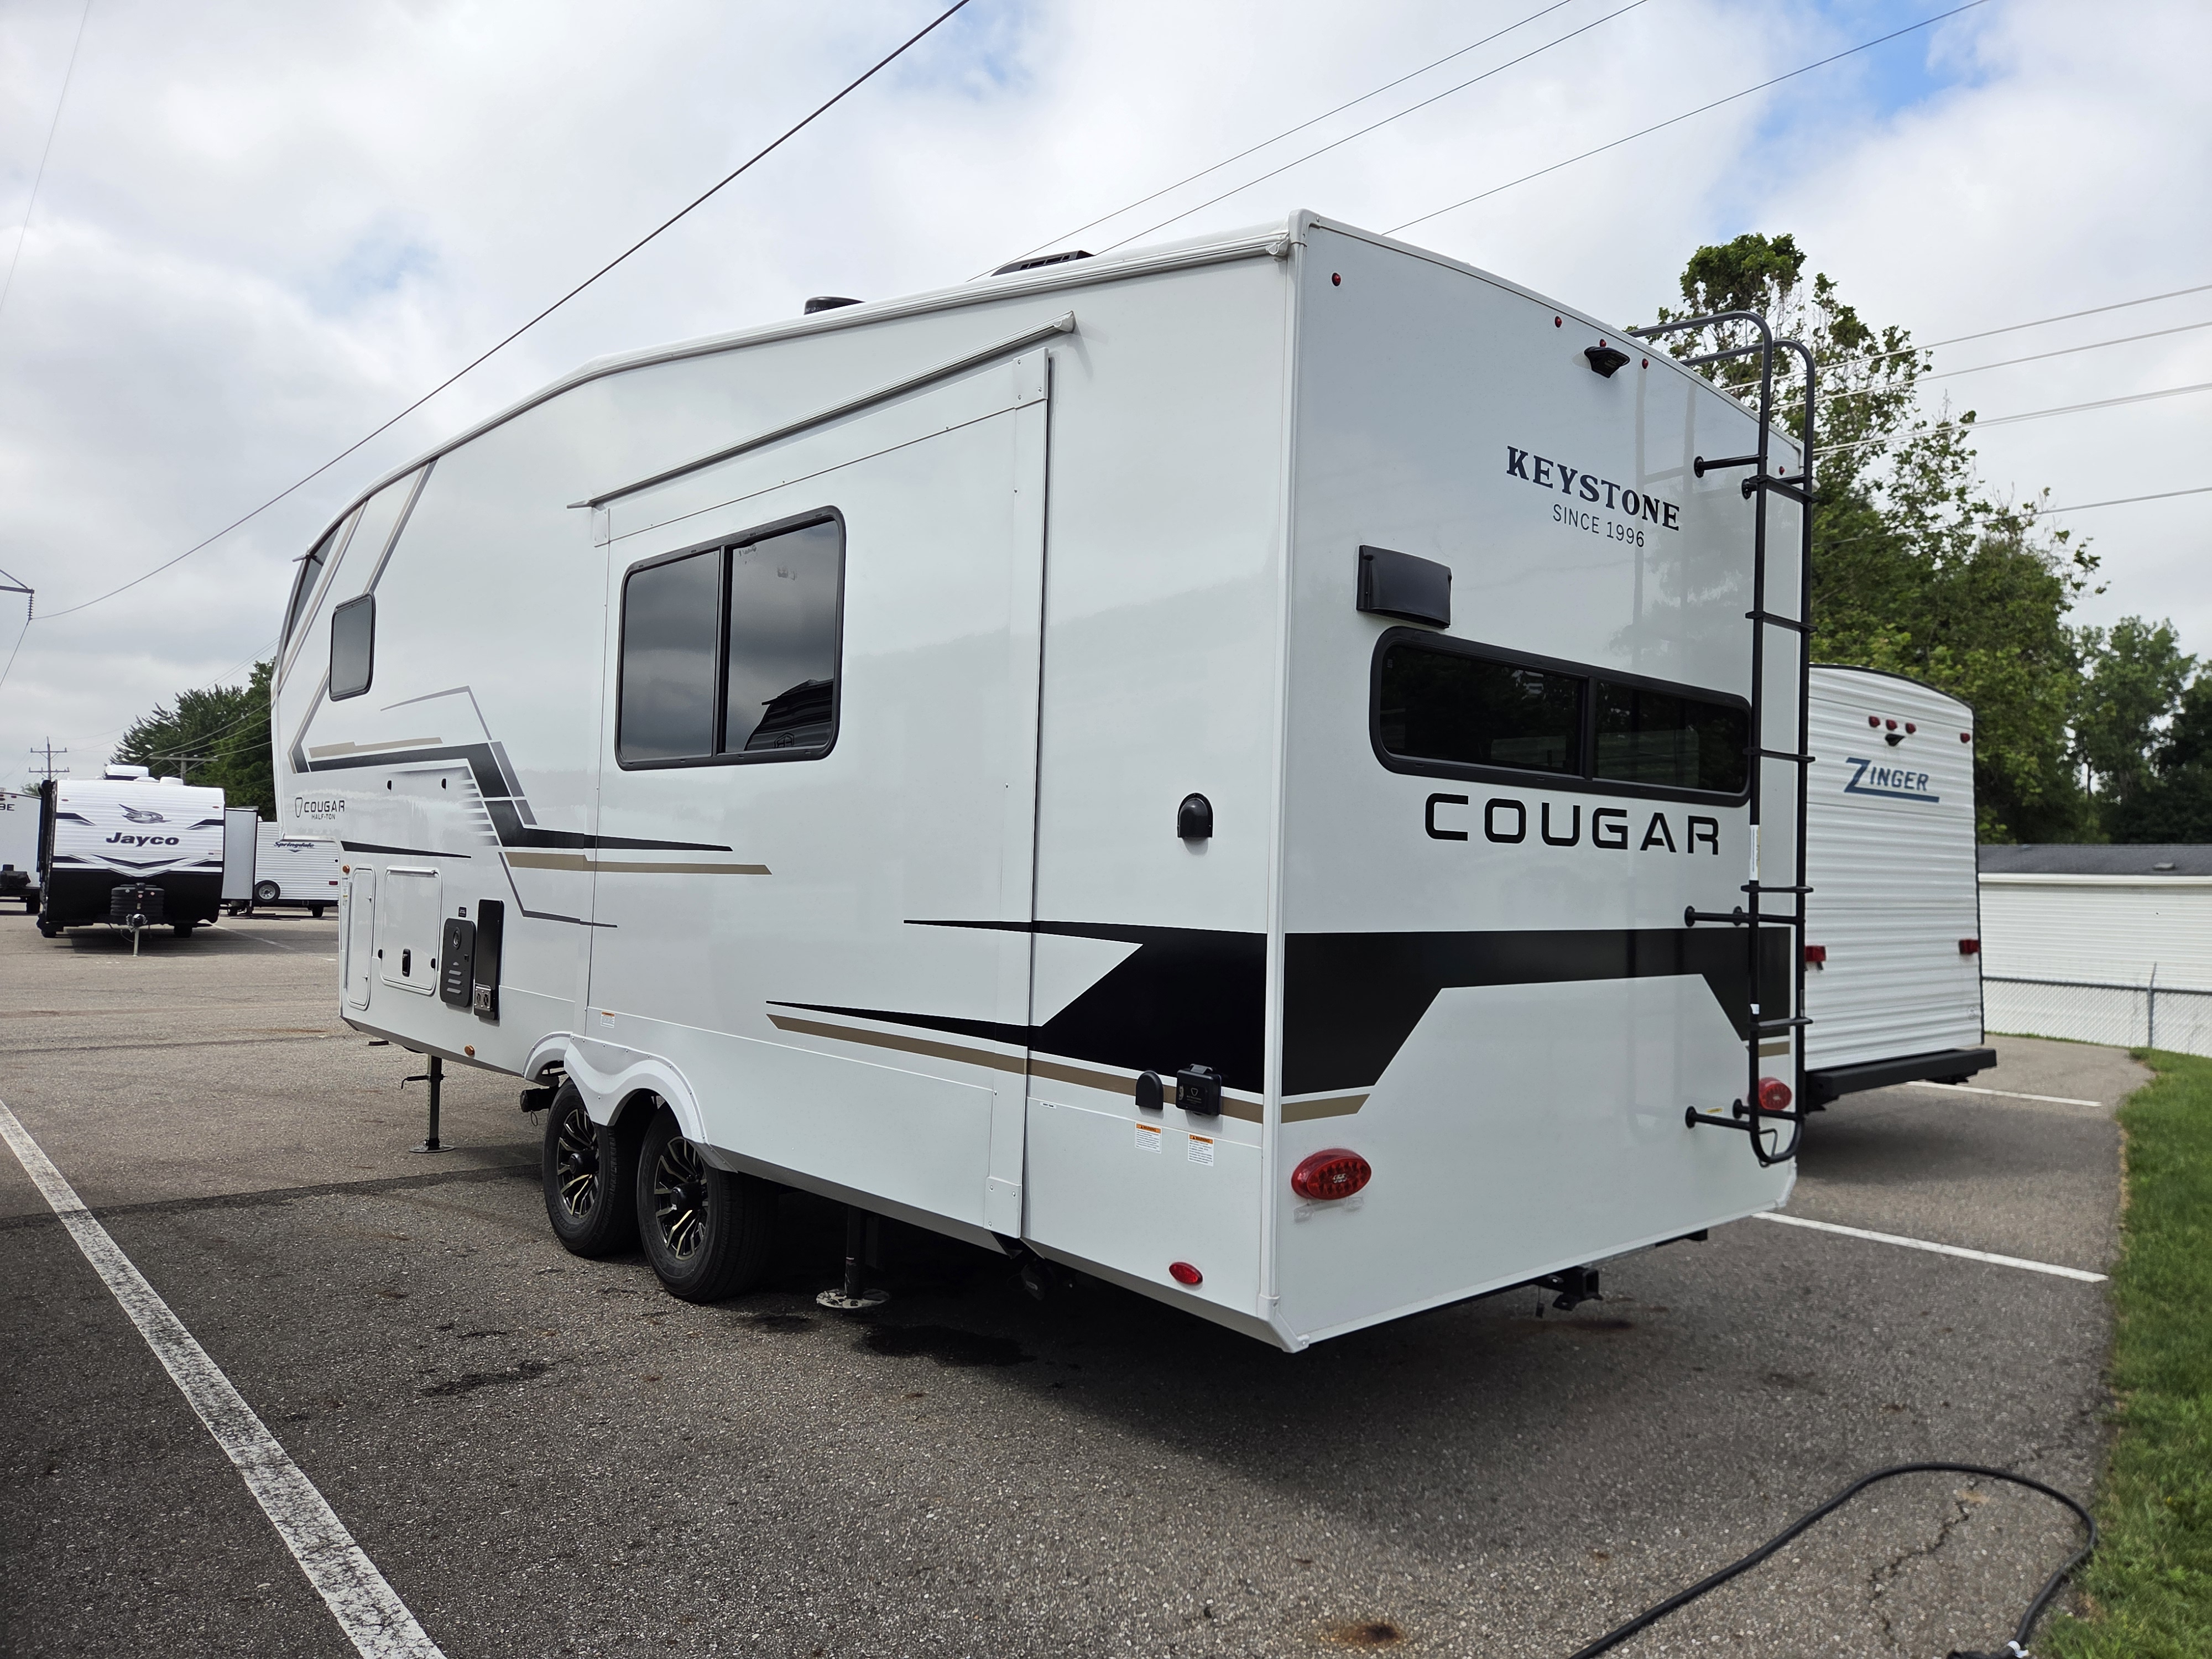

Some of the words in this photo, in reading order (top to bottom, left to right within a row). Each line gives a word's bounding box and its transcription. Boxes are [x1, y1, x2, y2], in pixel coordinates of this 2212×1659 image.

[1506, 445, 1680, 531] KEYSTONE
[1553, 504, 1600, 534] SINCE
[1606, 521, 1645, 548] 1996
[1844, 757, 1939, 803] ZINGER
[304, 800, 345, 813] COUGAR
[1425, 792, 1719, 855] COUGAR
[106, 832, 180, 847] Jayco
